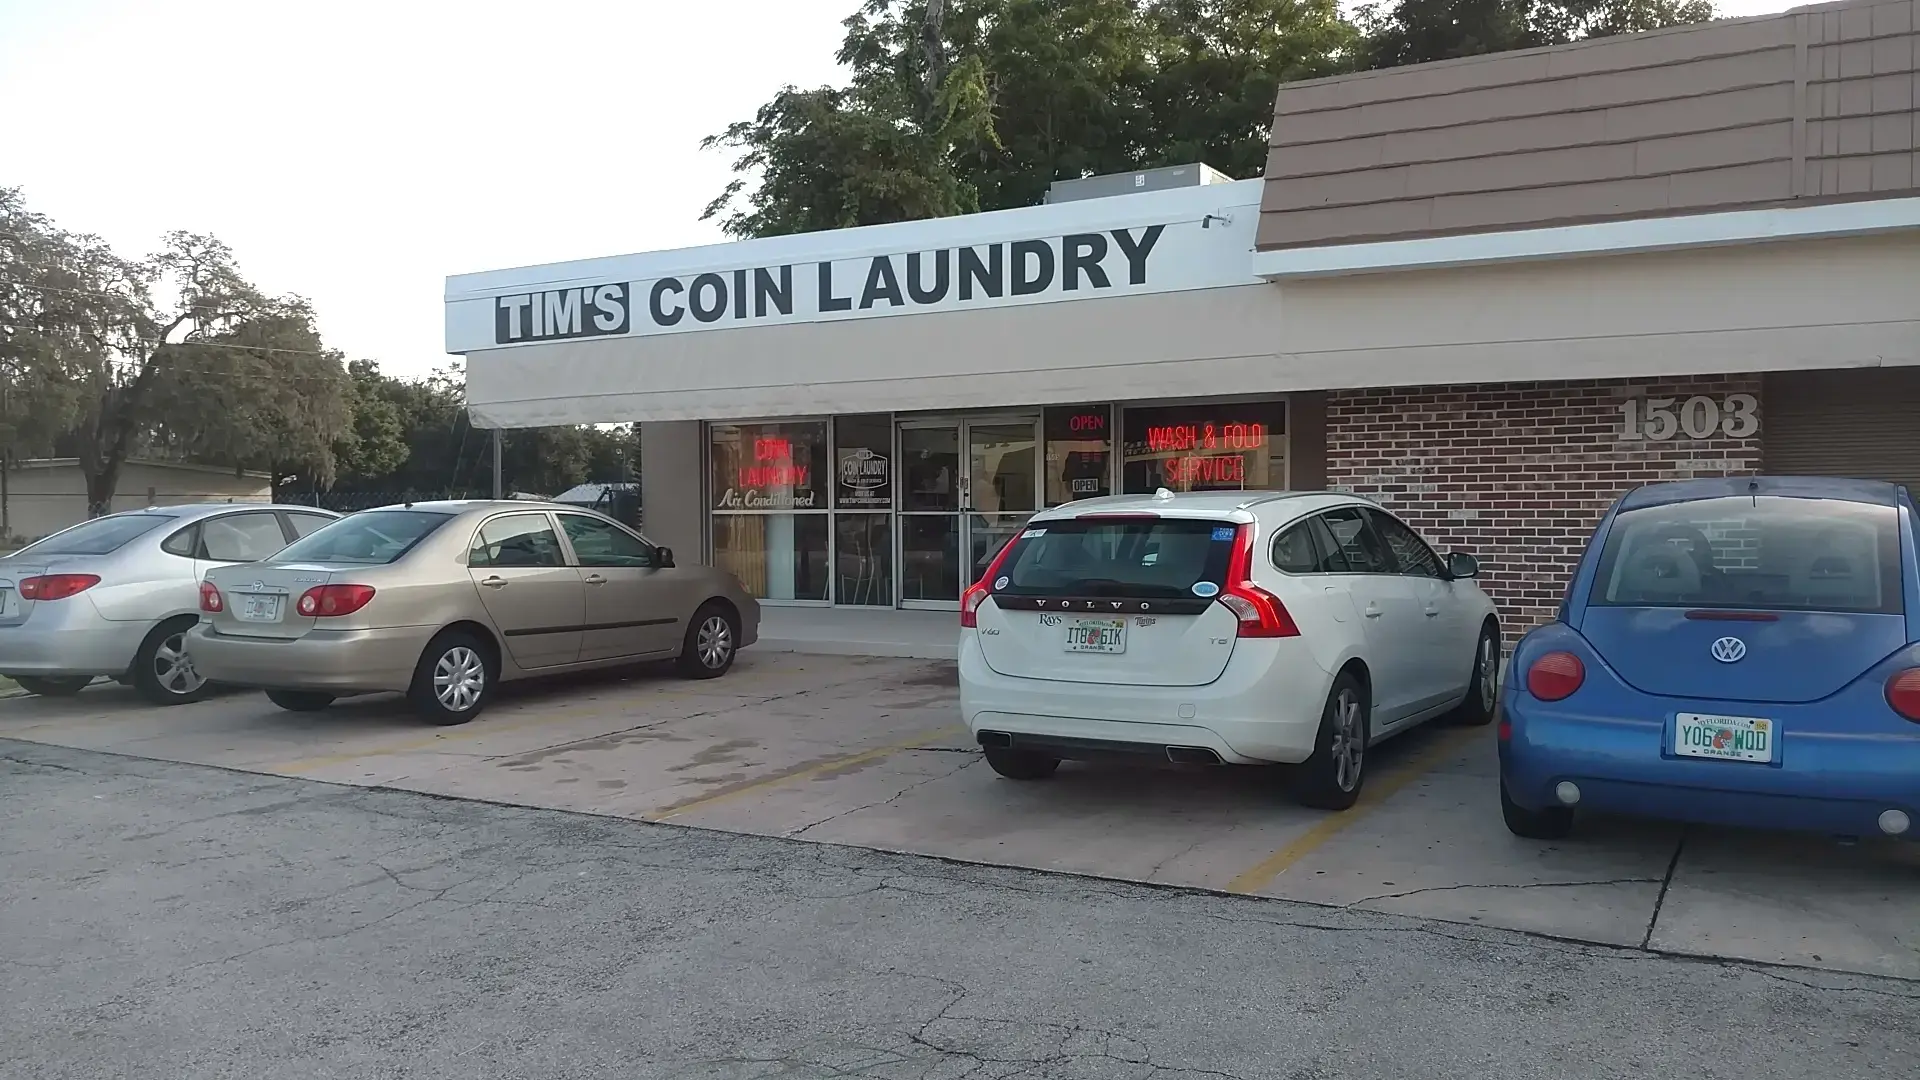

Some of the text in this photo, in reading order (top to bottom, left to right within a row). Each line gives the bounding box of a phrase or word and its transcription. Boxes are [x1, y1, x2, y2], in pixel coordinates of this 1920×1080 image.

[499, 224, 1167, 340] TIM'S COIN LAUNDRY
[1070, 415, 1104, 431] OPEN
[1618, 394, 1759, 441] 1503
[1148, 423, 1262, 451] WASH & FOLD
[860, 460, 886, 475] LAUNDRY
[1165, 456, 1244, 482] SERVICE
[739, 465, 808, 487] LAUNDRY
[1074, 480, 1097, 491] OPEN
[718, 488, 815, 508] Air Conditioned
[1036, 599, 1150, 610] VOLVO
[1134, 616, 1157, 627] Twins
[982, 628, 1000, 636] V60
[1703, 748, 1742, 757] ORANGE
